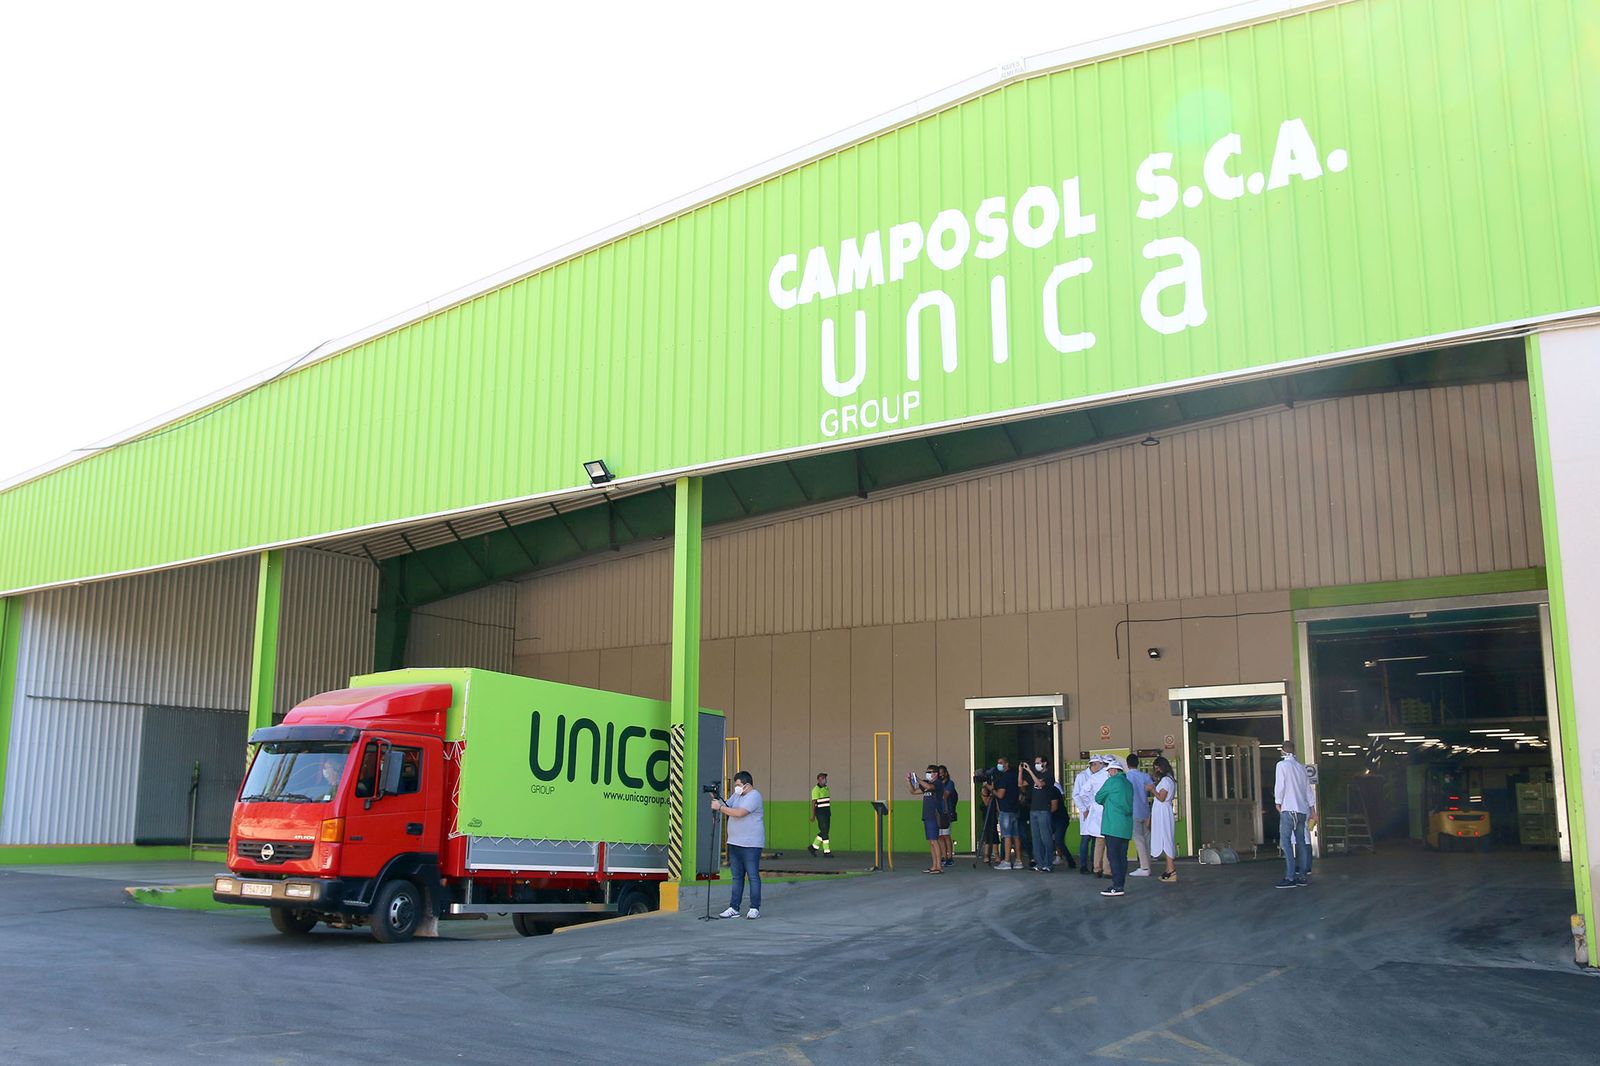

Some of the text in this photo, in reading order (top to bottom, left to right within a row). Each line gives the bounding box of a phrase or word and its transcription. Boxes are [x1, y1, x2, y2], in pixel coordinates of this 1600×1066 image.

[769, 119, 1348, 310] CAMPOSOL S.C.A.
[820, 390, 920, 437] GROUP
[530, 784, 556, 795] GROUP
[603, 791, 671, 807] www.unicagroup.e
